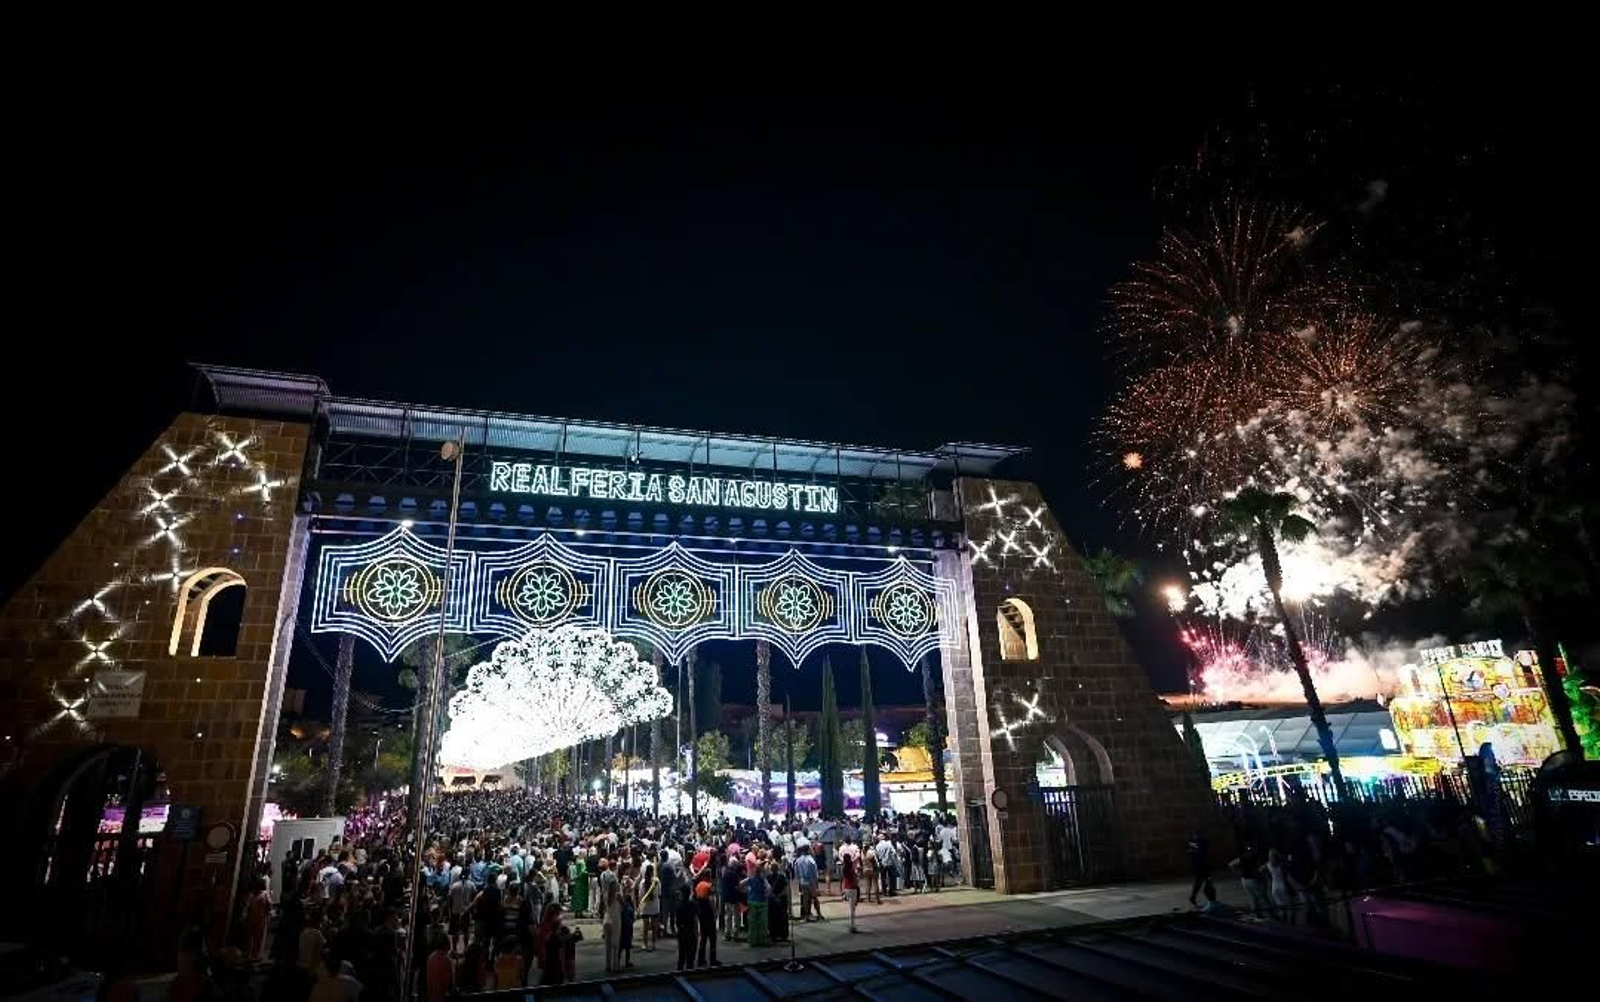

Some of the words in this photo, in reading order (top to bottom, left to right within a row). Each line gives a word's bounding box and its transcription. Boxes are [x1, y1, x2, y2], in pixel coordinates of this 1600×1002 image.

[490, 462, 568, 495] REAL
[570, 467, 662, 501] FERIA
[668, 475, 719, 506] SAN
[725, 479, 838, 513] AGUSTIN
